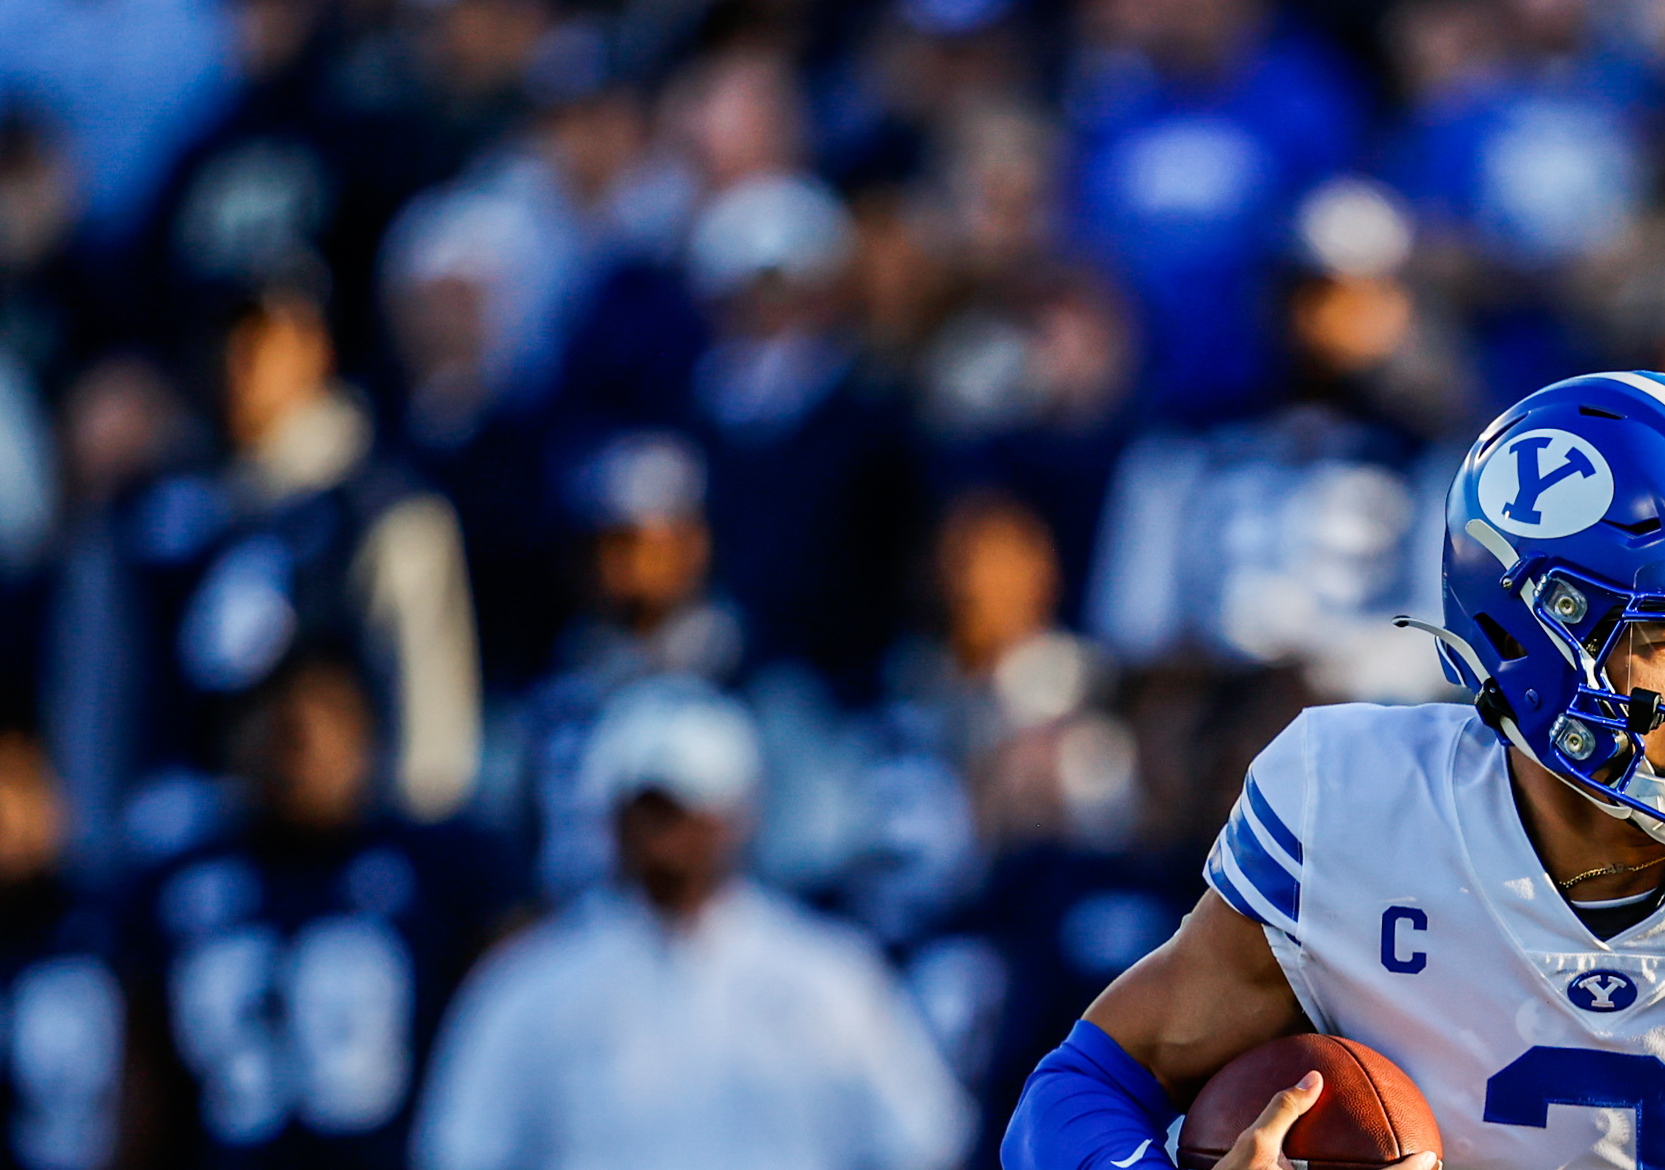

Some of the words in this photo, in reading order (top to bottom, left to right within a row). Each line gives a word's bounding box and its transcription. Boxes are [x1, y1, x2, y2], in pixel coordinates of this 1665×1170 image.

[1502, 437, 1596, 525] Y
[1381, 906, 1428, 974] C
[1578, 975, 1627, 1008] Y
